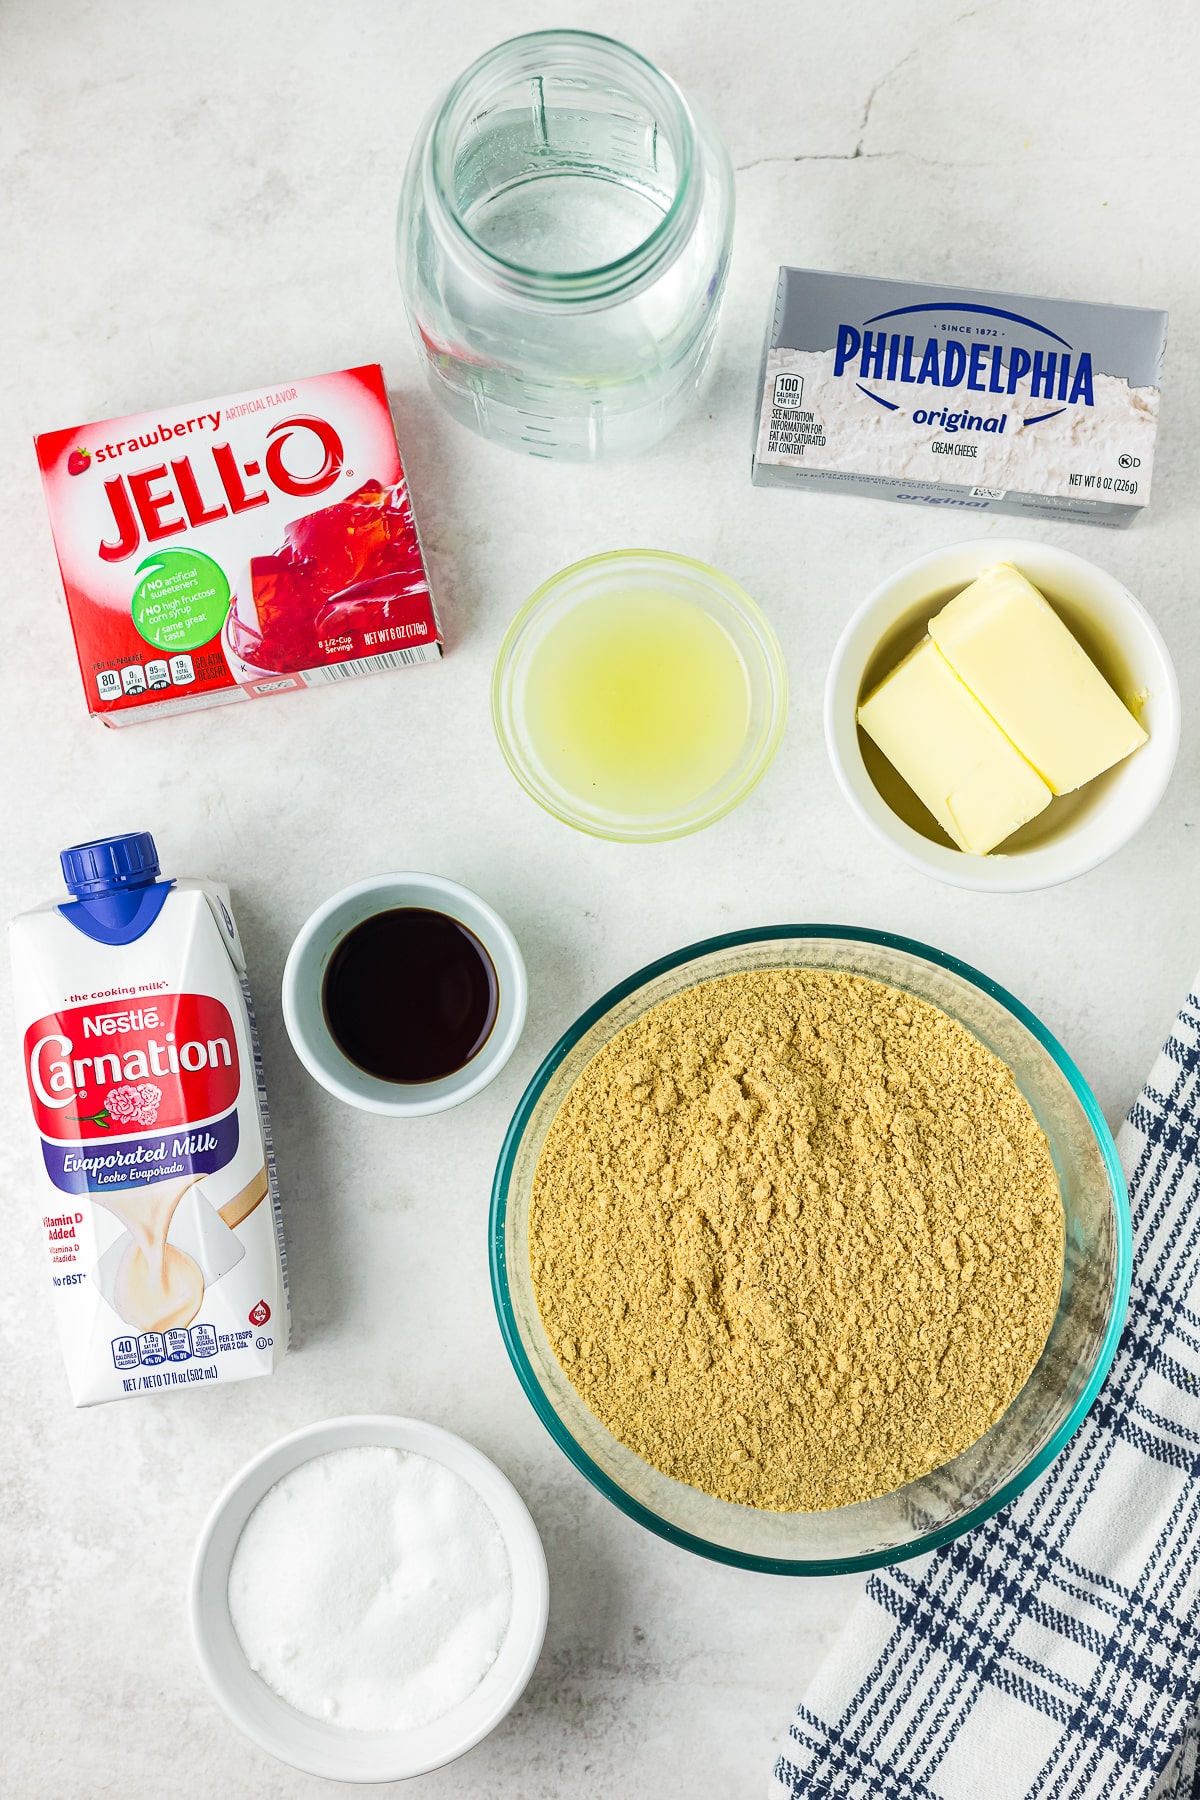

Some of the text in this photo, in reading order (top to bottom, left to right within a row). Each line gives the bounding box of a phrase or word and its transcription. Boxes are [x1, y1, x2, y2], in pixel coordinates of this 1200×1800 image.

[941, 324, 998, 337] SINCE 1872
[833, 323, 1095, 406] PHILADELPHIA
[780, 378, 798, 392] 100
[776, 391, 800, 400] CALORIES
[772, 409, 814, 422] SEE NUTRITION
[912, 407, 1008, 434] original
[95, 388, 299, 463] strawberry ARTIFICIAL FLAVOR
[770, 420, 822, 434] INFORMATION FOR
[770, 430, 826, 446] FAT AND SATURATED
[768, 442, 805, 455] FAT CONTENT
[932, 441, 978, 458] CREAM CHEESE
[1068, 474, 1138, 495] NET WT 8 OZ (226g)
[896, 494, 990, 508] original
[147, 567, 198, 591] NO artificial
[150, 579, 198, 600] sweeteners
[146, 588, 216, 616] NO high fructose
[148, 606, 192, 624] corn syrup
[162, 613, 207, 634] same great
[164, 630, 186, 642] taste
[364, 621, 428, 646] NET WT 6 OZ (170g)
[324, 636, 352, 648] 1/2-Cup
[325, 644, 354, 654] Servings
[116, 654, 144, 664] PACKAGE
[195, 652, 224, 668] GELATIN
[198, 664, 226, 682] DESSERT
[240, 664, 247, 672] K
[102, 674, 115, 686] 80
[150, 672, 167, 680] SODIUM
[175, 673, 192, 681] SUGARS
[100, 685, 121, 694] CALORIES
[70, 993, 89, 1003] the
[91, 986, 136, 1000] cooking
[82, 1006, 160, 1039] Nestlé
[30, 1032, 232, 1109] Carnation
[64, 1132, 218, 1177] Evaporated Milk
[97, 1162, 185, 1185] Leche Evaporada
[42, 1212, 84, 1228] Vitamin D
[48, 1226, 76, 1241] Added
[74, 1244, 80, 1252] D
[52, 1276, 62, 1287] No
[254, 1309, 266, 1318] REAL
[196, 1334, 210, 1342] TOTAL
[196, 1339, 215, 1347] SUGARS
[218, 1334, 230, 1343] PER
[234, 1330, 253, 1340] TBSPS
[118, 1340, 132, 1354] 40
[220, 1343, 232, 1352] POR
[116, 1352, 138, 1361] CALORIES
[122, 1378, 136, 1392] NET
[143, 1374, 162, 1389] NETO
[163, 1372, 170, 1386] 17
[178, 1373, 186, 1384] oz
